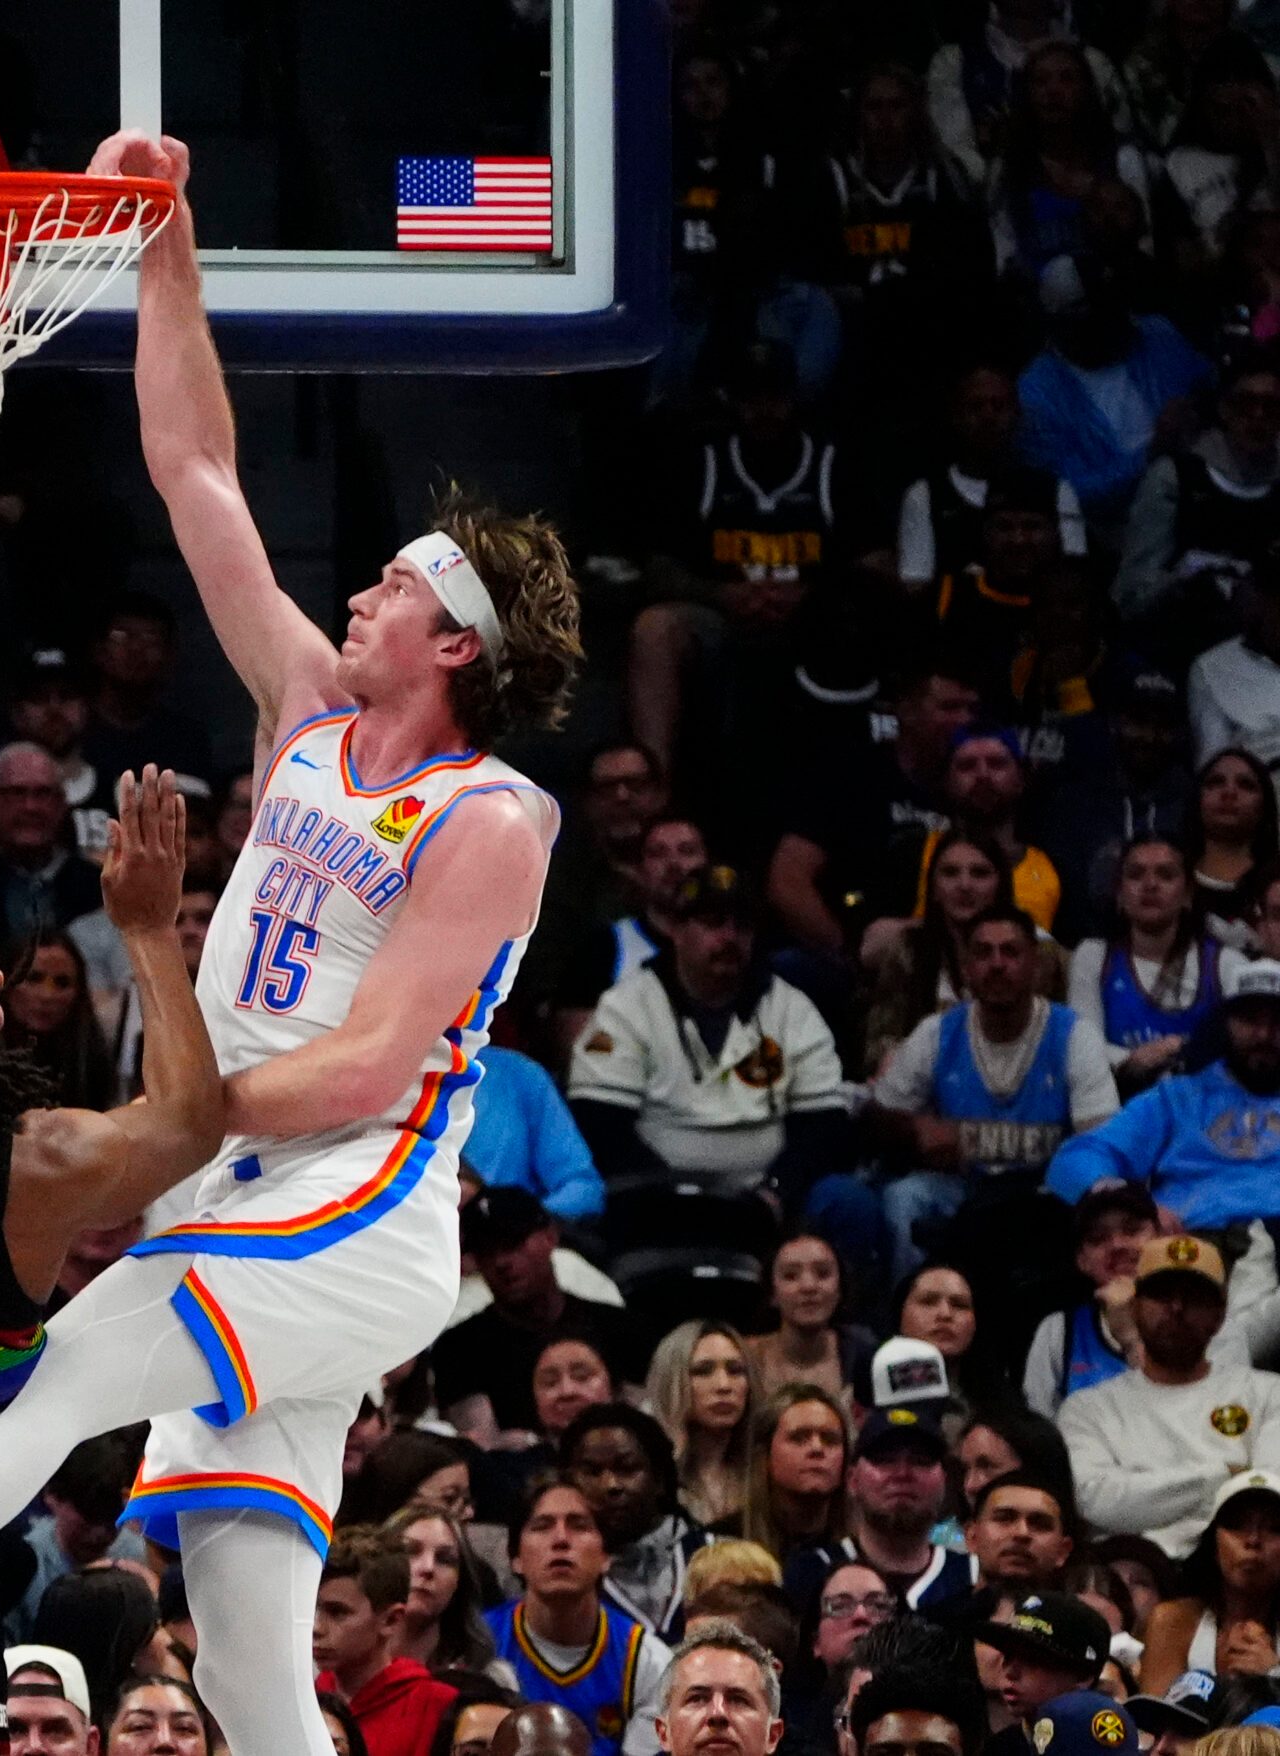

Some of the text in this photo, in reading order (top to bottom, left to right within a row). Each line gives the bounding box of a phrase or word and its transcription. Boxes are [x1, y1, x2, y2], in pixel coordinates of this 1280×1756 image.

[253, 796, 410, 916] OKLAHOMA
[255, 857, 335, 928] CITY
[235, 907, 321, 1015] 15
